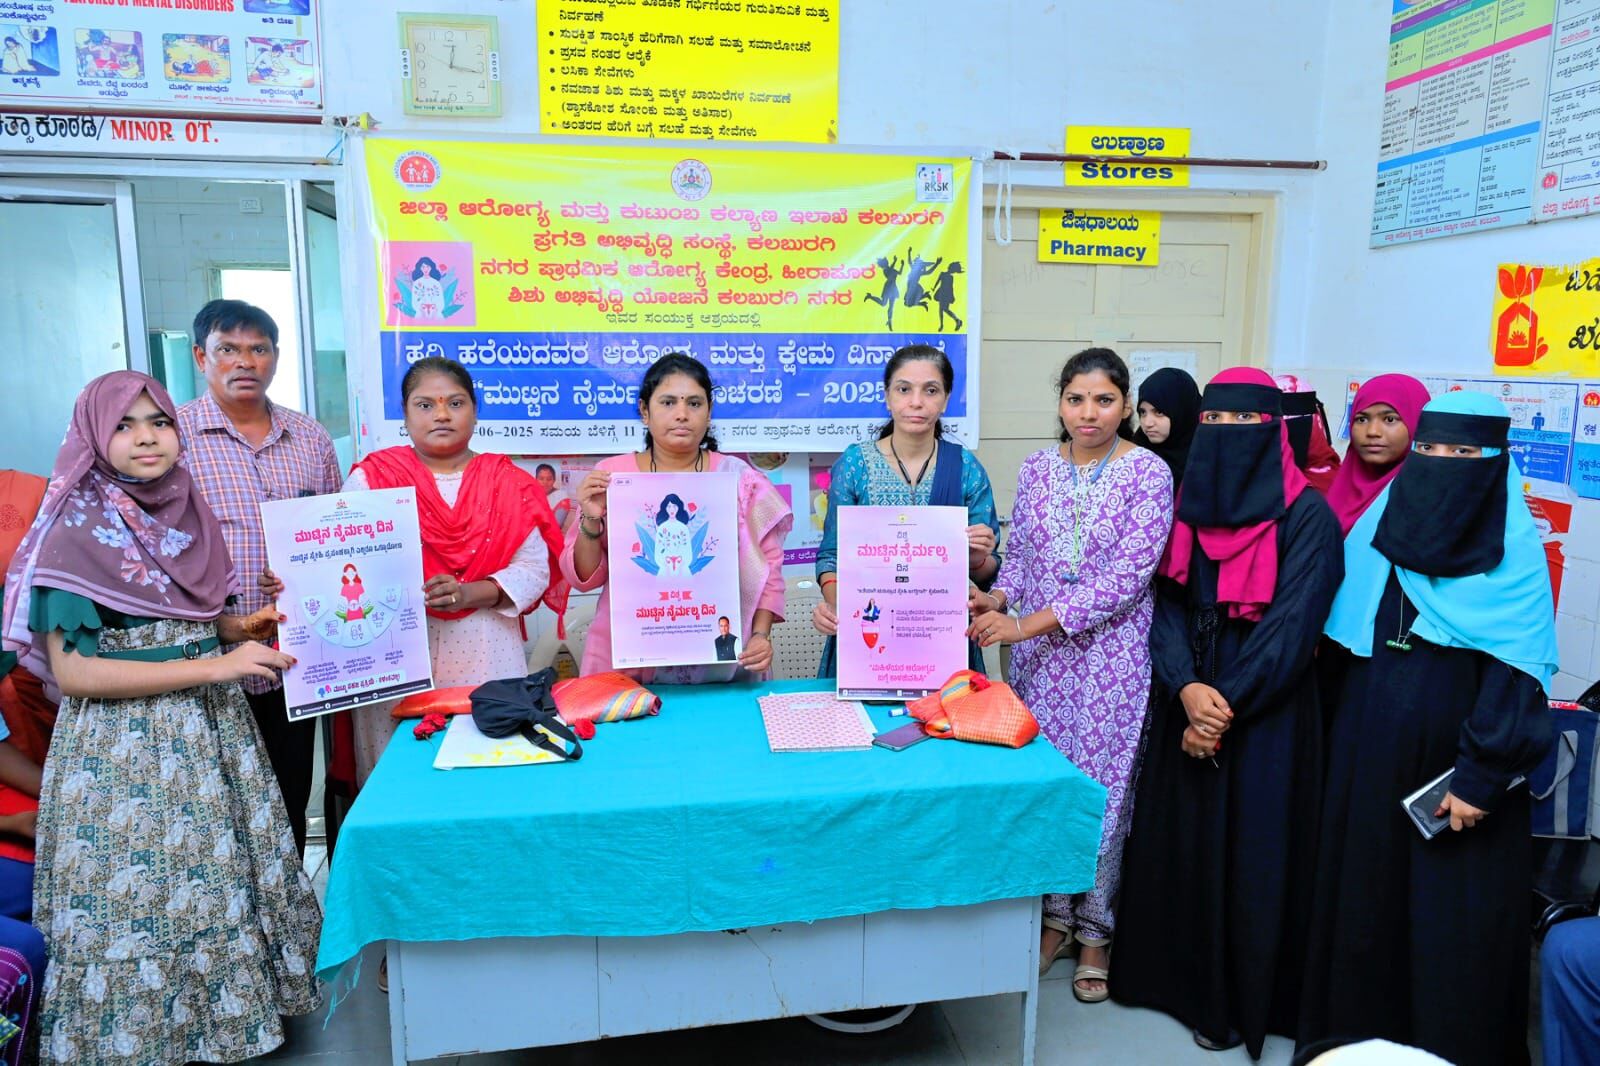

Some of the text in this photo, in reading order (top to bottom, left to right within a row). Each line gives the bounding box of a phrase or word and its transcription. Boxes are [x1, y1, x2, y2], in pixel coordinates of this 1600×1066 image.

[559, 10, 604, 24] ನಿರ್ವಹಣೆ
[805, 8, 830, 22] ಮತ್ತು
[559, 29, 595, 46] ಸುರಕ್ಷಿತ
[688, 35, 714, 48] ಸಲಹೆ
[719, 38, 744, 53] ಮತ್ತು
[560, 47, 586, 61] ಪ್ರಸವ
[591, 49, 621, 60] ನಂತರ
[560, 65, 635, 79] ಲಸಿಕಾ ಸೇವೆಗಳು
[561, 83, 600, 96] ನವಜಾತ
[605, 84, 623, 96] ಶಿಶು
[629, 87, 654, 102] ಮತ್ತು
[663, 107, 688, 121] ಮತ್ತು
[110, 119, 174, 142] MINOR
[185, 121, 219, 143] OT.
[607, 121, 631, 132] ಹೆರಿಗೆ
[636, 122, 655, 138] ಬಗ್ಗೆ
[659, 124, 684, 135] ಸಲಹೆ
[690, 125, 714, 140] ಮತ್ತು
[718, 126, 757, 138] ಸೇವೆಗಳು
[1081, 162, 1173, 179] Stores
[925, 182, 949, 192] RKSK
[400, 198, 945, 232] ಜಿಲ್ಲಾ ಆರೋಗ್ಯ ಮತ್ತು ಕುಟುಂಬ ಕಲ್ಯಾಣ ಇಲಾಖೆ ಕಲಬುರಗಿ
[1061, 209, 1139, 233] ಔಷಧಾಲಯ
[533, 229, 587, 252] ಪ್ರಗತಿ
[597, 231, 673, 258] ಅಭಿವೃದ್ಧಿ
[747, 235, 836, 252] ಕಲಬುರಗಿ
[1050, 240, 1147, 262] Pharmacy
[480, 259, 529, 277] ನಗರ
[538, 260, 618, 282] ಪ್ರಾಥಮಿಕ
[628, 261, 707, 288] ಆರೋಗ್ಯ
[508, 286, 852, 314] ಶಿಶು ಅಭಿವೃದ್ಧಿ ಯೋಜನೆ ಕಲಬುರಗಿ ನಗರ
[606, 312, 761, 329] ಇವರ ಸಂಯುಕ್ತ ಆಶ್ರಯದಲ್ಲಿ
[710, 340, 766, 373] ಮತ್ತು
[777, 339, 835, 375] ಕ್ಷೇಮ
[540, 426, 581, 438] ಸಮಯ
[732, 424, 757, 435] ನಗರ
[763, 424, 810, 439] ಪ್ರಾಥಮಿಕ
[817, 424, 862, 441] ಆರೋಗ್ಯ
[295, 520, 394, 545] ಮುಟ್ಟಿನ ನೈರ್ಮಲ್ಯ ದಿನ
[857, 542, 948, 563] ಮುಟ್ಟಿನ ನೈರ್ಮಲ್ಯ
[896, 563, 909, 572] ದಿನ
[636, 604, 716, 622] ಮುಟ್ಟಿನ ನೈರ್ಮಲ್ಯ ದಿನ
